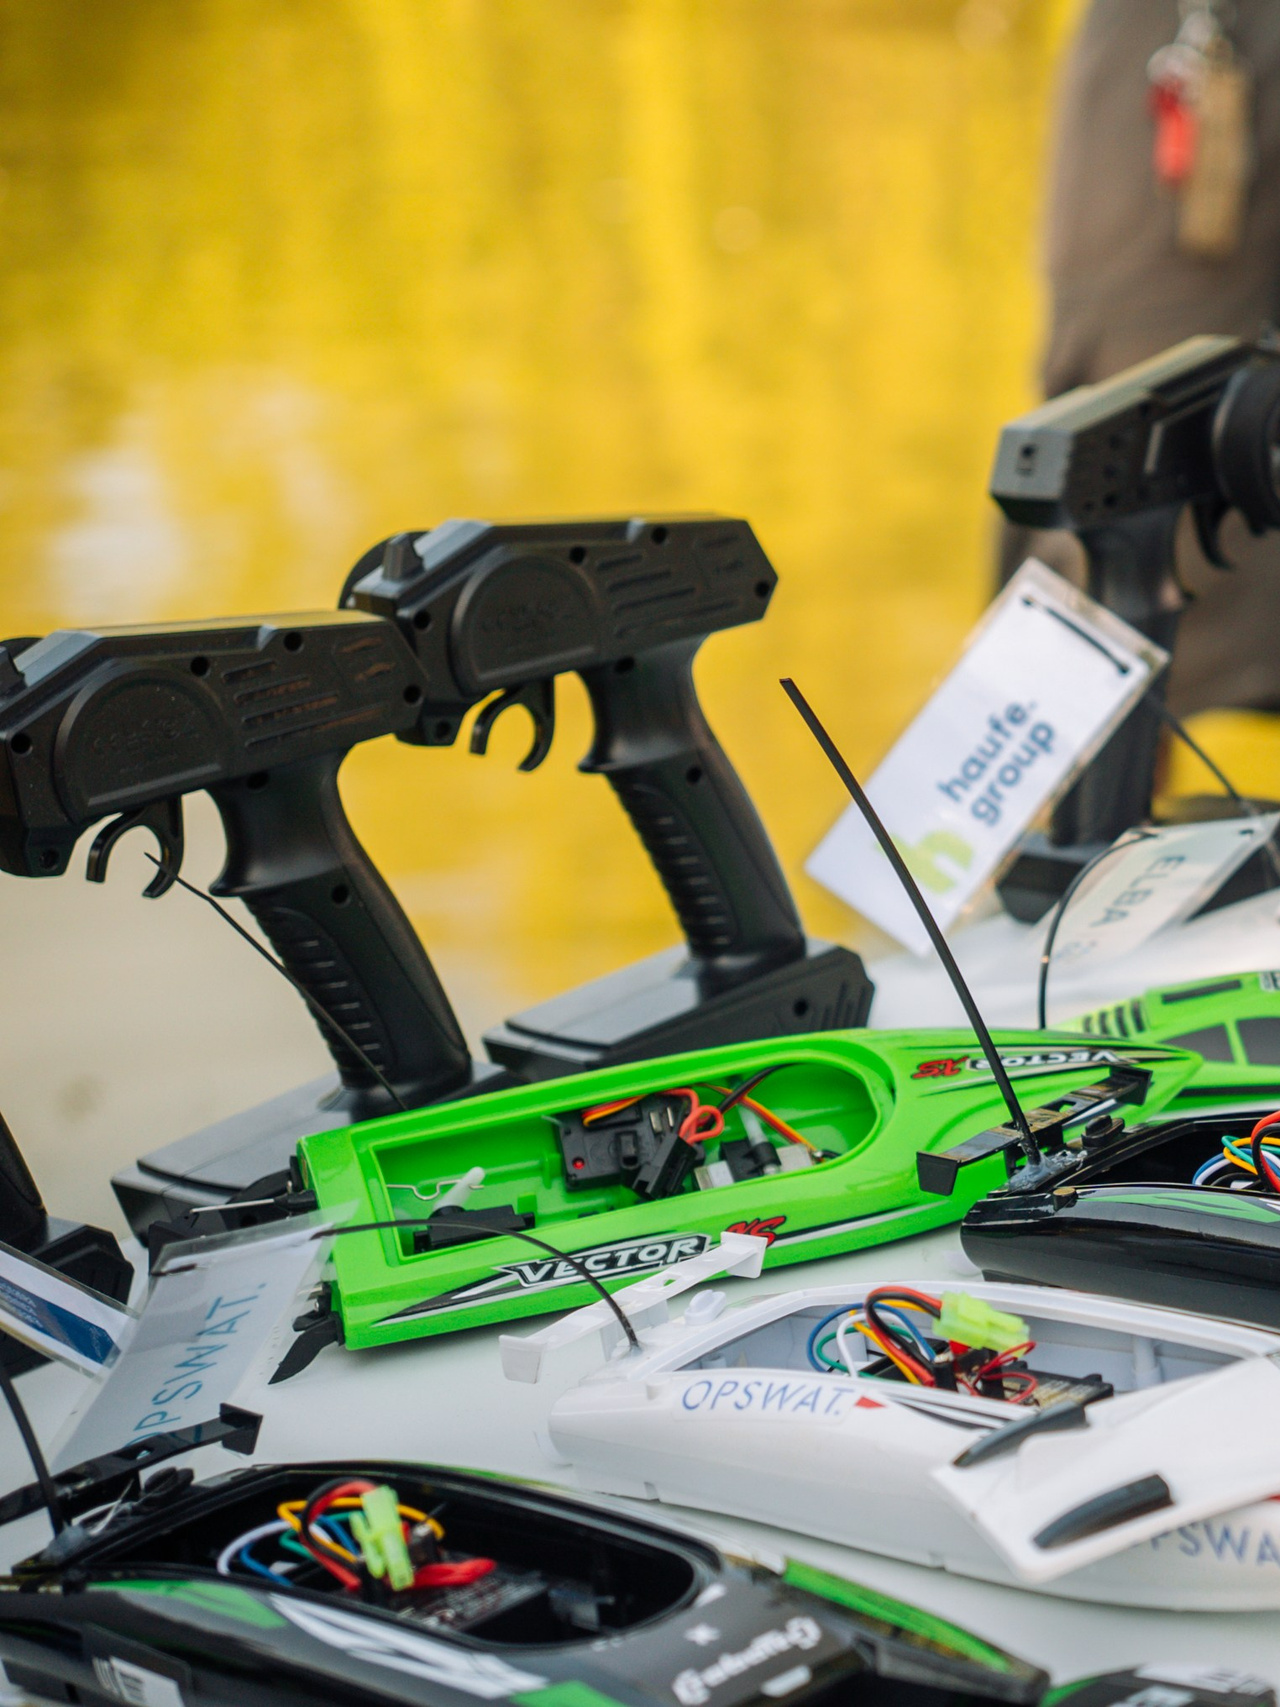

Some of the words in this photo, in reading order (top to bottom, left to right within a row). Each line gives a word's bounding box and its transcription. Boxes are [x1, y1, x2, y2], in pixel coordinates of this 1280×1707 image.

[937, 700, 1038, 803] haufe.
[971, 721, 1056, 825] group
[1089, 855, 1187, 928] ELBA
[518, 1236, 701, 1283] VECTOR
[682, 1380, 855, 1416] OPSWAT.
